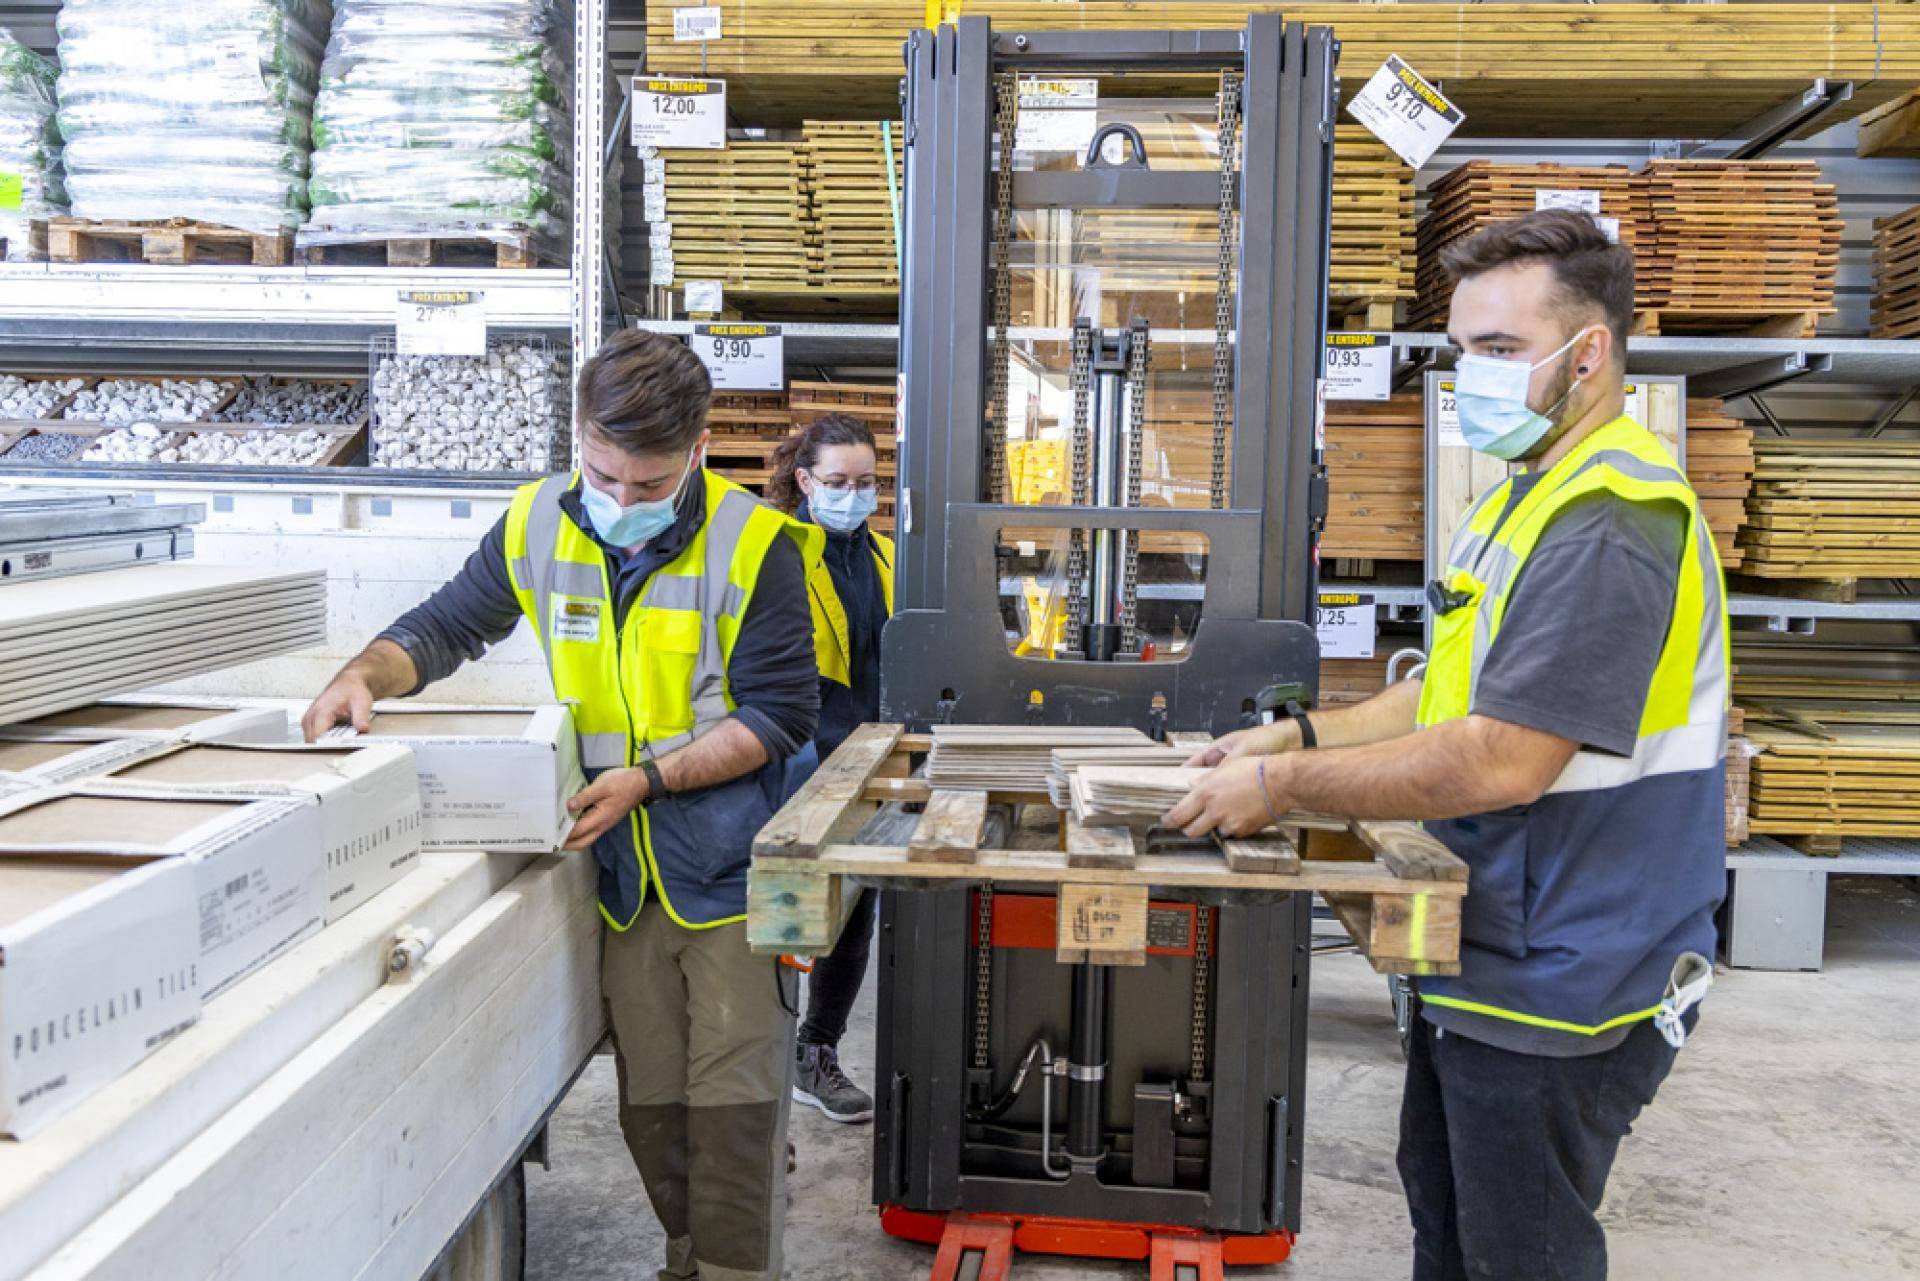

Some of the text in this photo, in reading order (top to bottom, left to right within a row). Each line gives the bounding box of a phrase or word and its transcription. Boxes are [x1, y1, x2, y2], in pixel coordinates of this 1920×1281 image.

[327, 824, 391, 872] PORCELAIN
[397, 810, 420, 836] TILE
[14, 986, 143, 1060] PORCELAIN
[158, 963, 197, 1001] TILE
